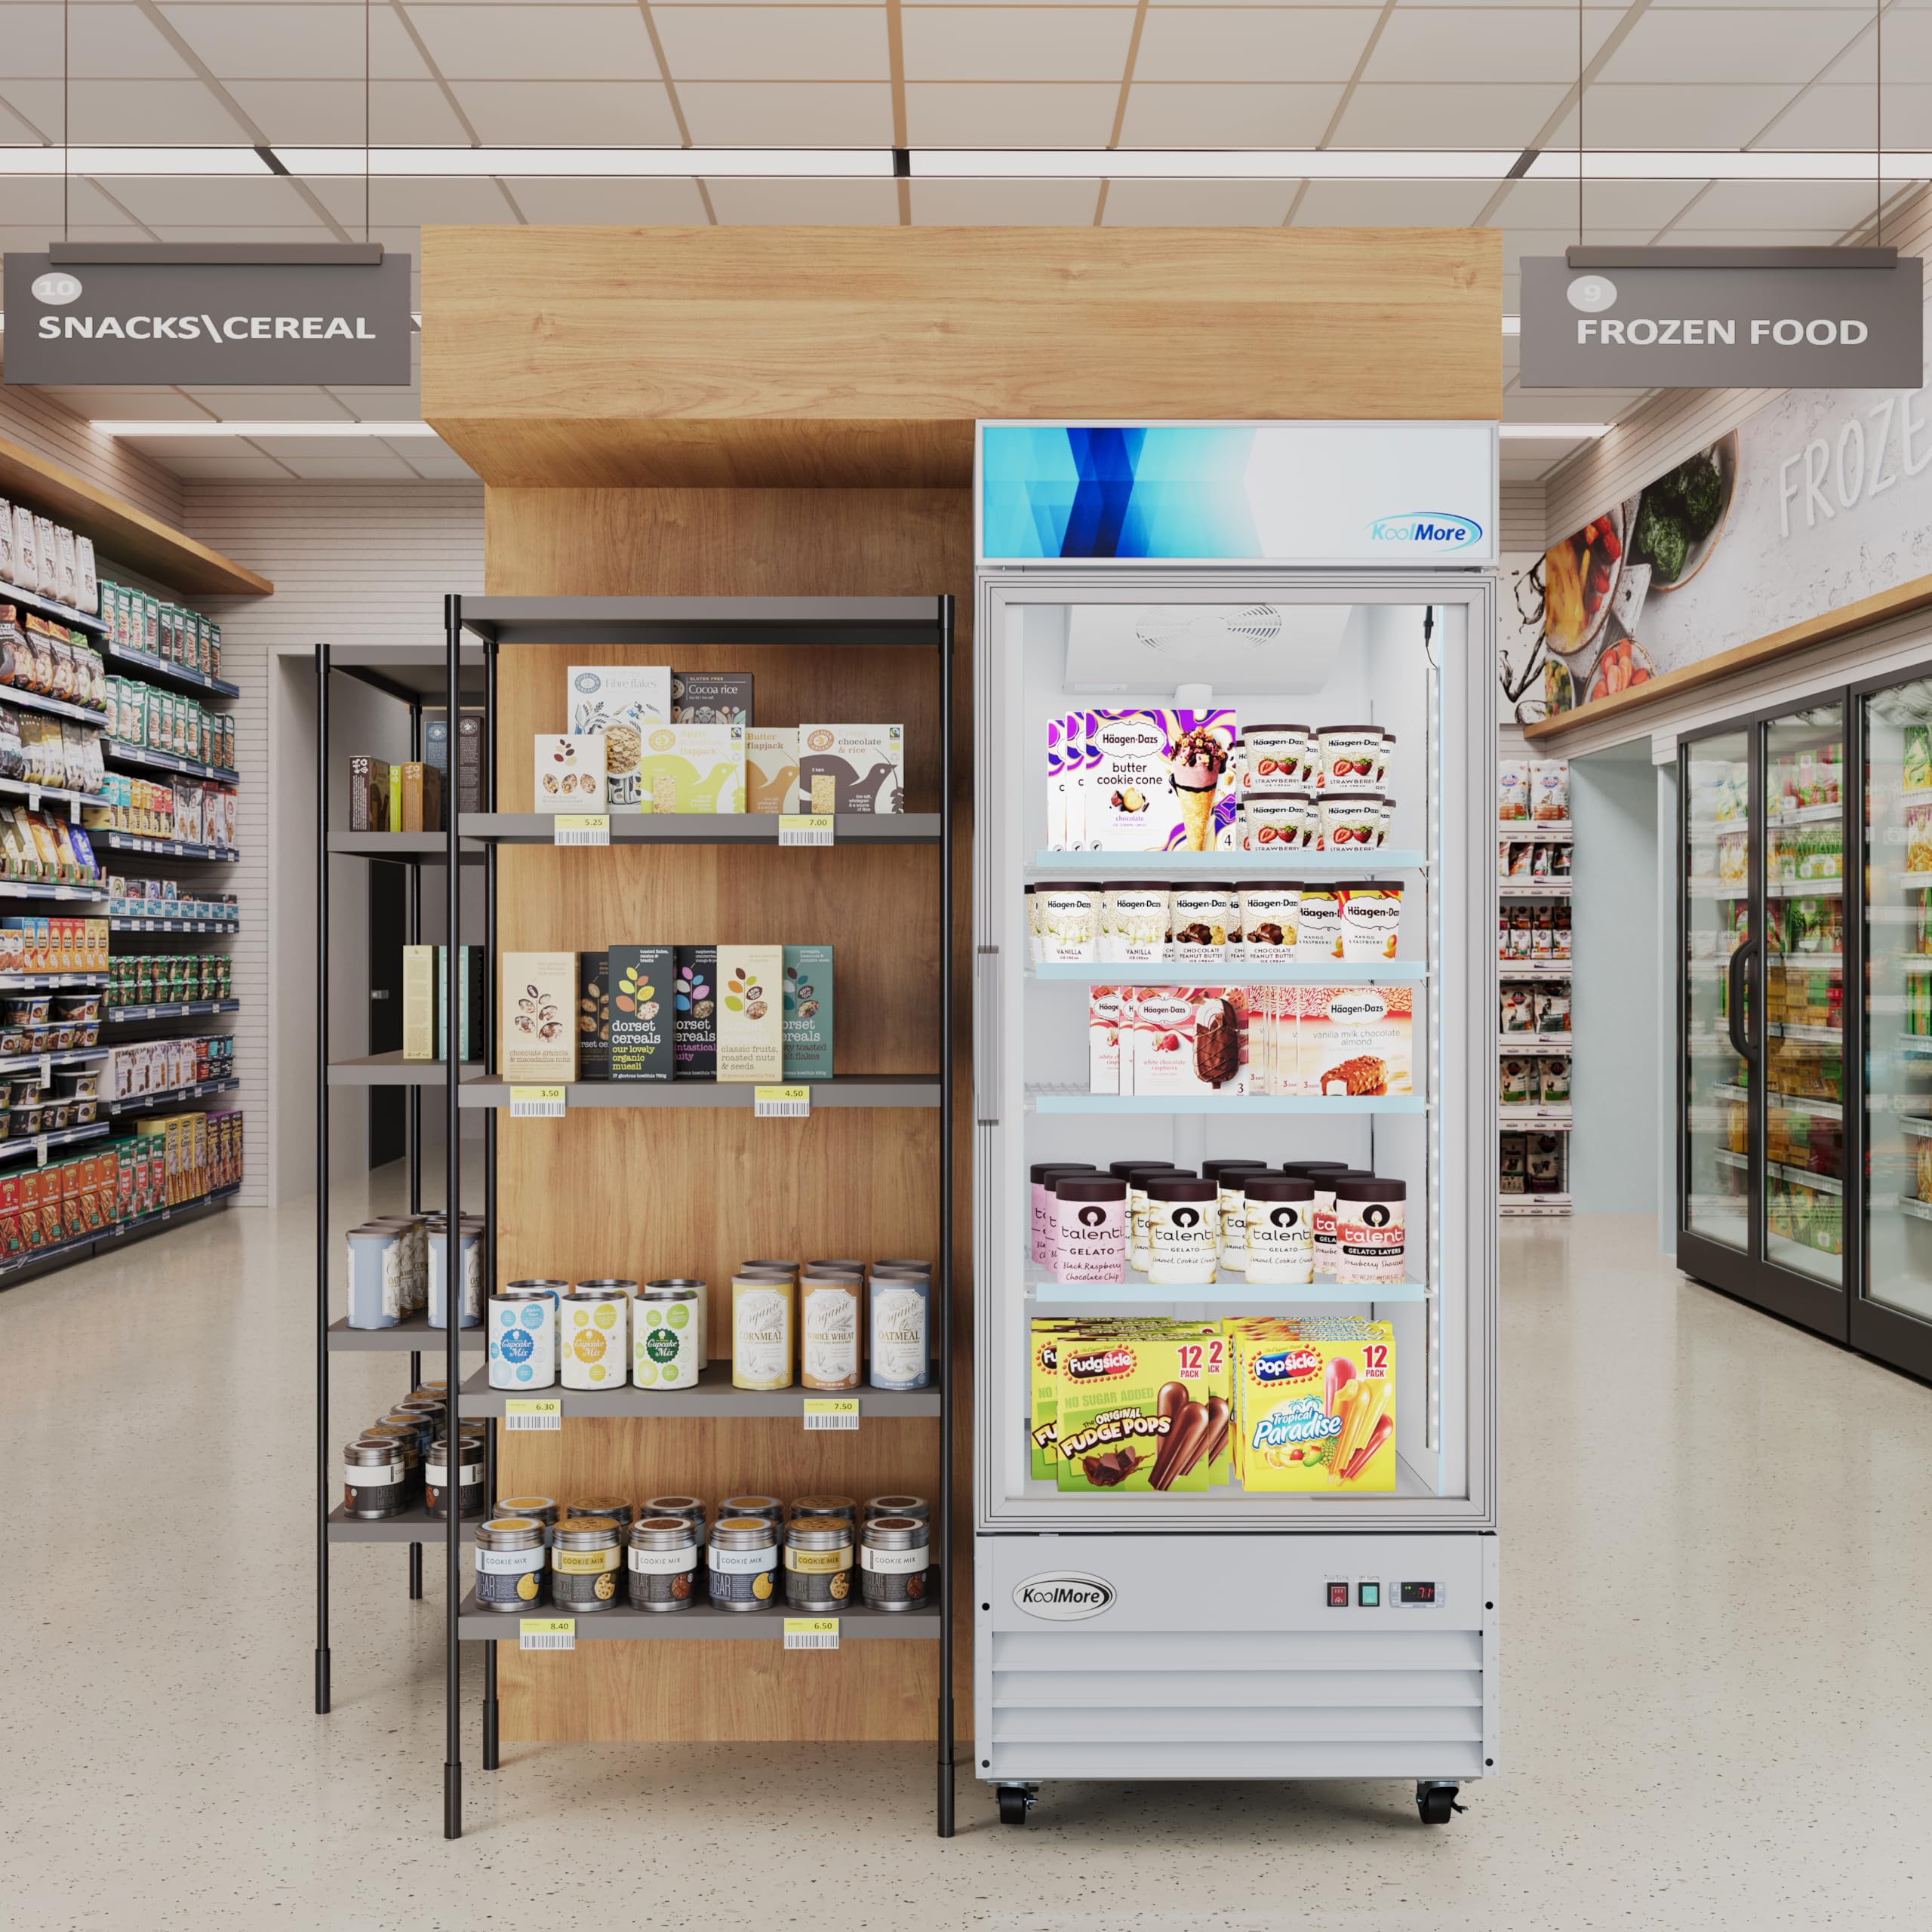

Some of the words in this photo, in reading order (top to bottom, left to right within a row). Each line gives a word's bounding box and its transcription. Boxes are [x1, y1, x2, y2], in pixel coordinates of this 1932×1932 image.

[38, 280, 75, 296] 10
[1585, 285, 1601, 301] 9
[38, 315, 376, 343] SNACKS\CEREAL
[1577, 319, 1736, 345] FROZEN
[1750, 319, 1869, 345] FOOD
[1371, 523, 1466, 541] KoolMore
[688, 685, 718, 694] Cocoa
[721, 685, 738, 694] rice
[1112, 762, 1147, 773] butter
[1097, 774, 1134, 785] cookie
[1135, 777, 1163, 785] cone
[1224, 834, 1232, 847] 4
[612, 1020, 656, 1032] dorset
[676, 1019, 711, 1030] orset
[783, 1019, 816, 1030] orset
[612, 1032, 661, 1044] cereals
[676, 1031, 715, 1041] ereals
[783, 1031, 821, 1041] ereals
[1313, 1031, 1339, 1039] vanilla
[1341, 1030, 1358, 1038] milk
[1360, 1029, 1401, 1038] chocolate
[796, 1043, 826, 1051] toasted
[1341, 1038, 1372, 1046] almond
[629, 1045, 655, 1054] lovely
[752, 1045, 779, 1054] fruits,
[612, 1054, 645, 1063] organic
[795, 1052, 820, 1060] flakes
[1237, 1083, 1244, 1094] 3
[1062, 1226, 1124, 1240] talenti
[1155, 1229, 1214, 1241] talenti
[1254, 1229, 1311, 1241] talenti
[1345, 1229, 1404, 1243] talenti
[1348, 1247, 1376, 1255] GELATO
[1379, 1247, 1401, 1255] LAYERS
[1082, 1263, 1121, 1272] Raspberry
[1344, 1258, 1379, 1269] Strawberry
[1104, 1273, 1119, 1281] Chip
[739, 1331, 783, 1341] CORNMEAL
[808, 1332, 829, 1340] WHOLE
[831, 1332, 854, 1340] WHEAT
[878, 1331, 920, 1340] OATMEAL
[502, 1339, 531, 1350] Cupcake
[574, 1339, 604, 1350] Cupcake
[647, 1339, 676, 1350] Cupcake
[509, 1348, 528, 1357] Mix
[582, 1348, 601, 1357] Mix
[655, 1348, 674, 1357] Mix
[1177, 1346, 1202, 1368] 12
[1363, 1345, 1388, 1368] 12
[1069, 1352, 1132, 1374] Fudgsicle
[1254, 1352, 1316, 1376] Popsicle
[1180, 1369, 1199, 1378] PACK
[1365, 1369, 1385, 1378] PACK
[1038, 1386, 1053, 1398] NO
[1065, 1396, 1080, 1409] NO
[1082, 1392, 1117, 1407] SUGAR
[1121, 1388, 1155, 1402] ADDED
[1083, 1419, 1095, 1429] The
[1095, 1407, 1142, 1424] ORIGINAL
[1272, 1407, 1313, 1426] Tropical
[1059, 1420, 1122, 1457] FUDGE
[1122, 1416, 1172, 1435] POPS
[1252, 1412, 1343, 1450] Paradise
[485, 1557, 512, 1565] COOKIE
[562, 1557, 589, 1565] COOKIE
[639, 1557, 666, 1565] COOKIE
[721, 1557, 748, 1565] COOKIE
[798, 1557, 825, 1565] COOKIE
[875, 1557, 902, 1565] COOKIE
[1023, 1587, 1100, 1605] KoolMore
